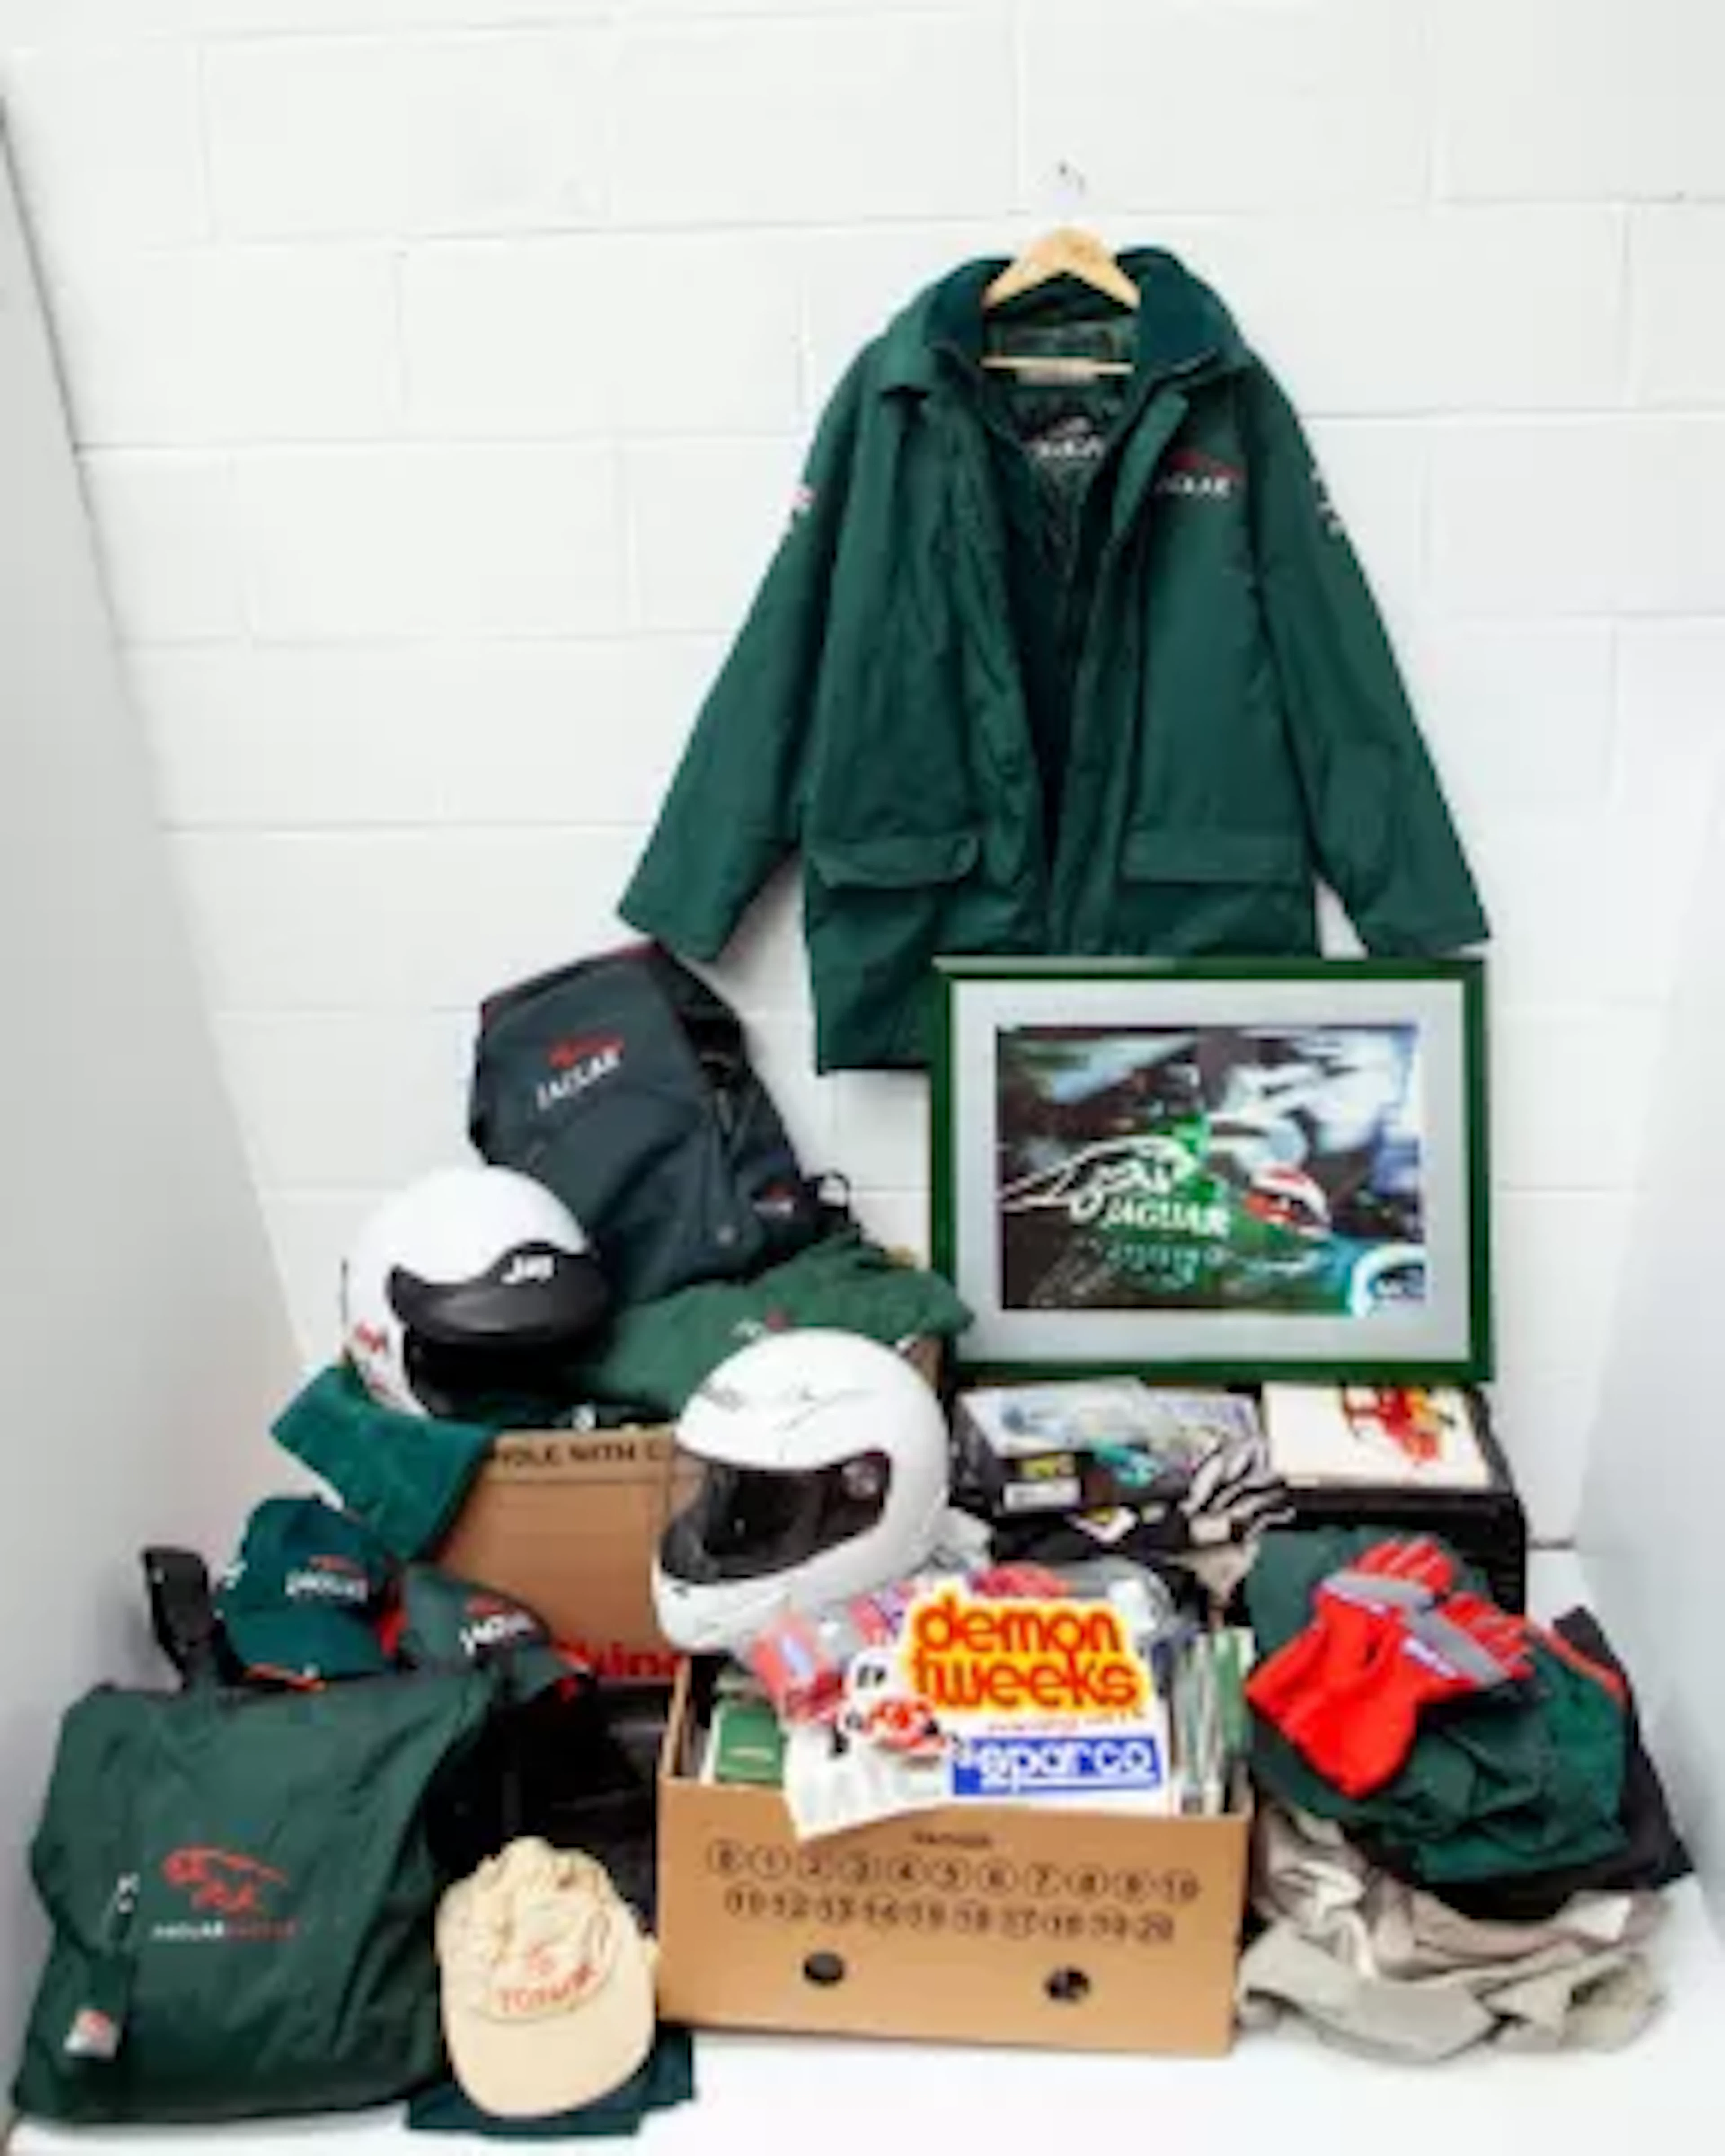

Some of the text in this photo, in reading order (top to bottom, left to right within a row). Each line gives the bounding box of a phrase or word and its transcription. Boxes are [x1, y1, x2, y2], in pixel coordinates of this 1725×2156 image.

[1100, 1195, 1231, 1238] JAGUAR
[914, 1595, 1123, 1653] demon
[912, 1646, 1139, 1709] tweeks
[975, 1738, 1154, 1792] sparco
